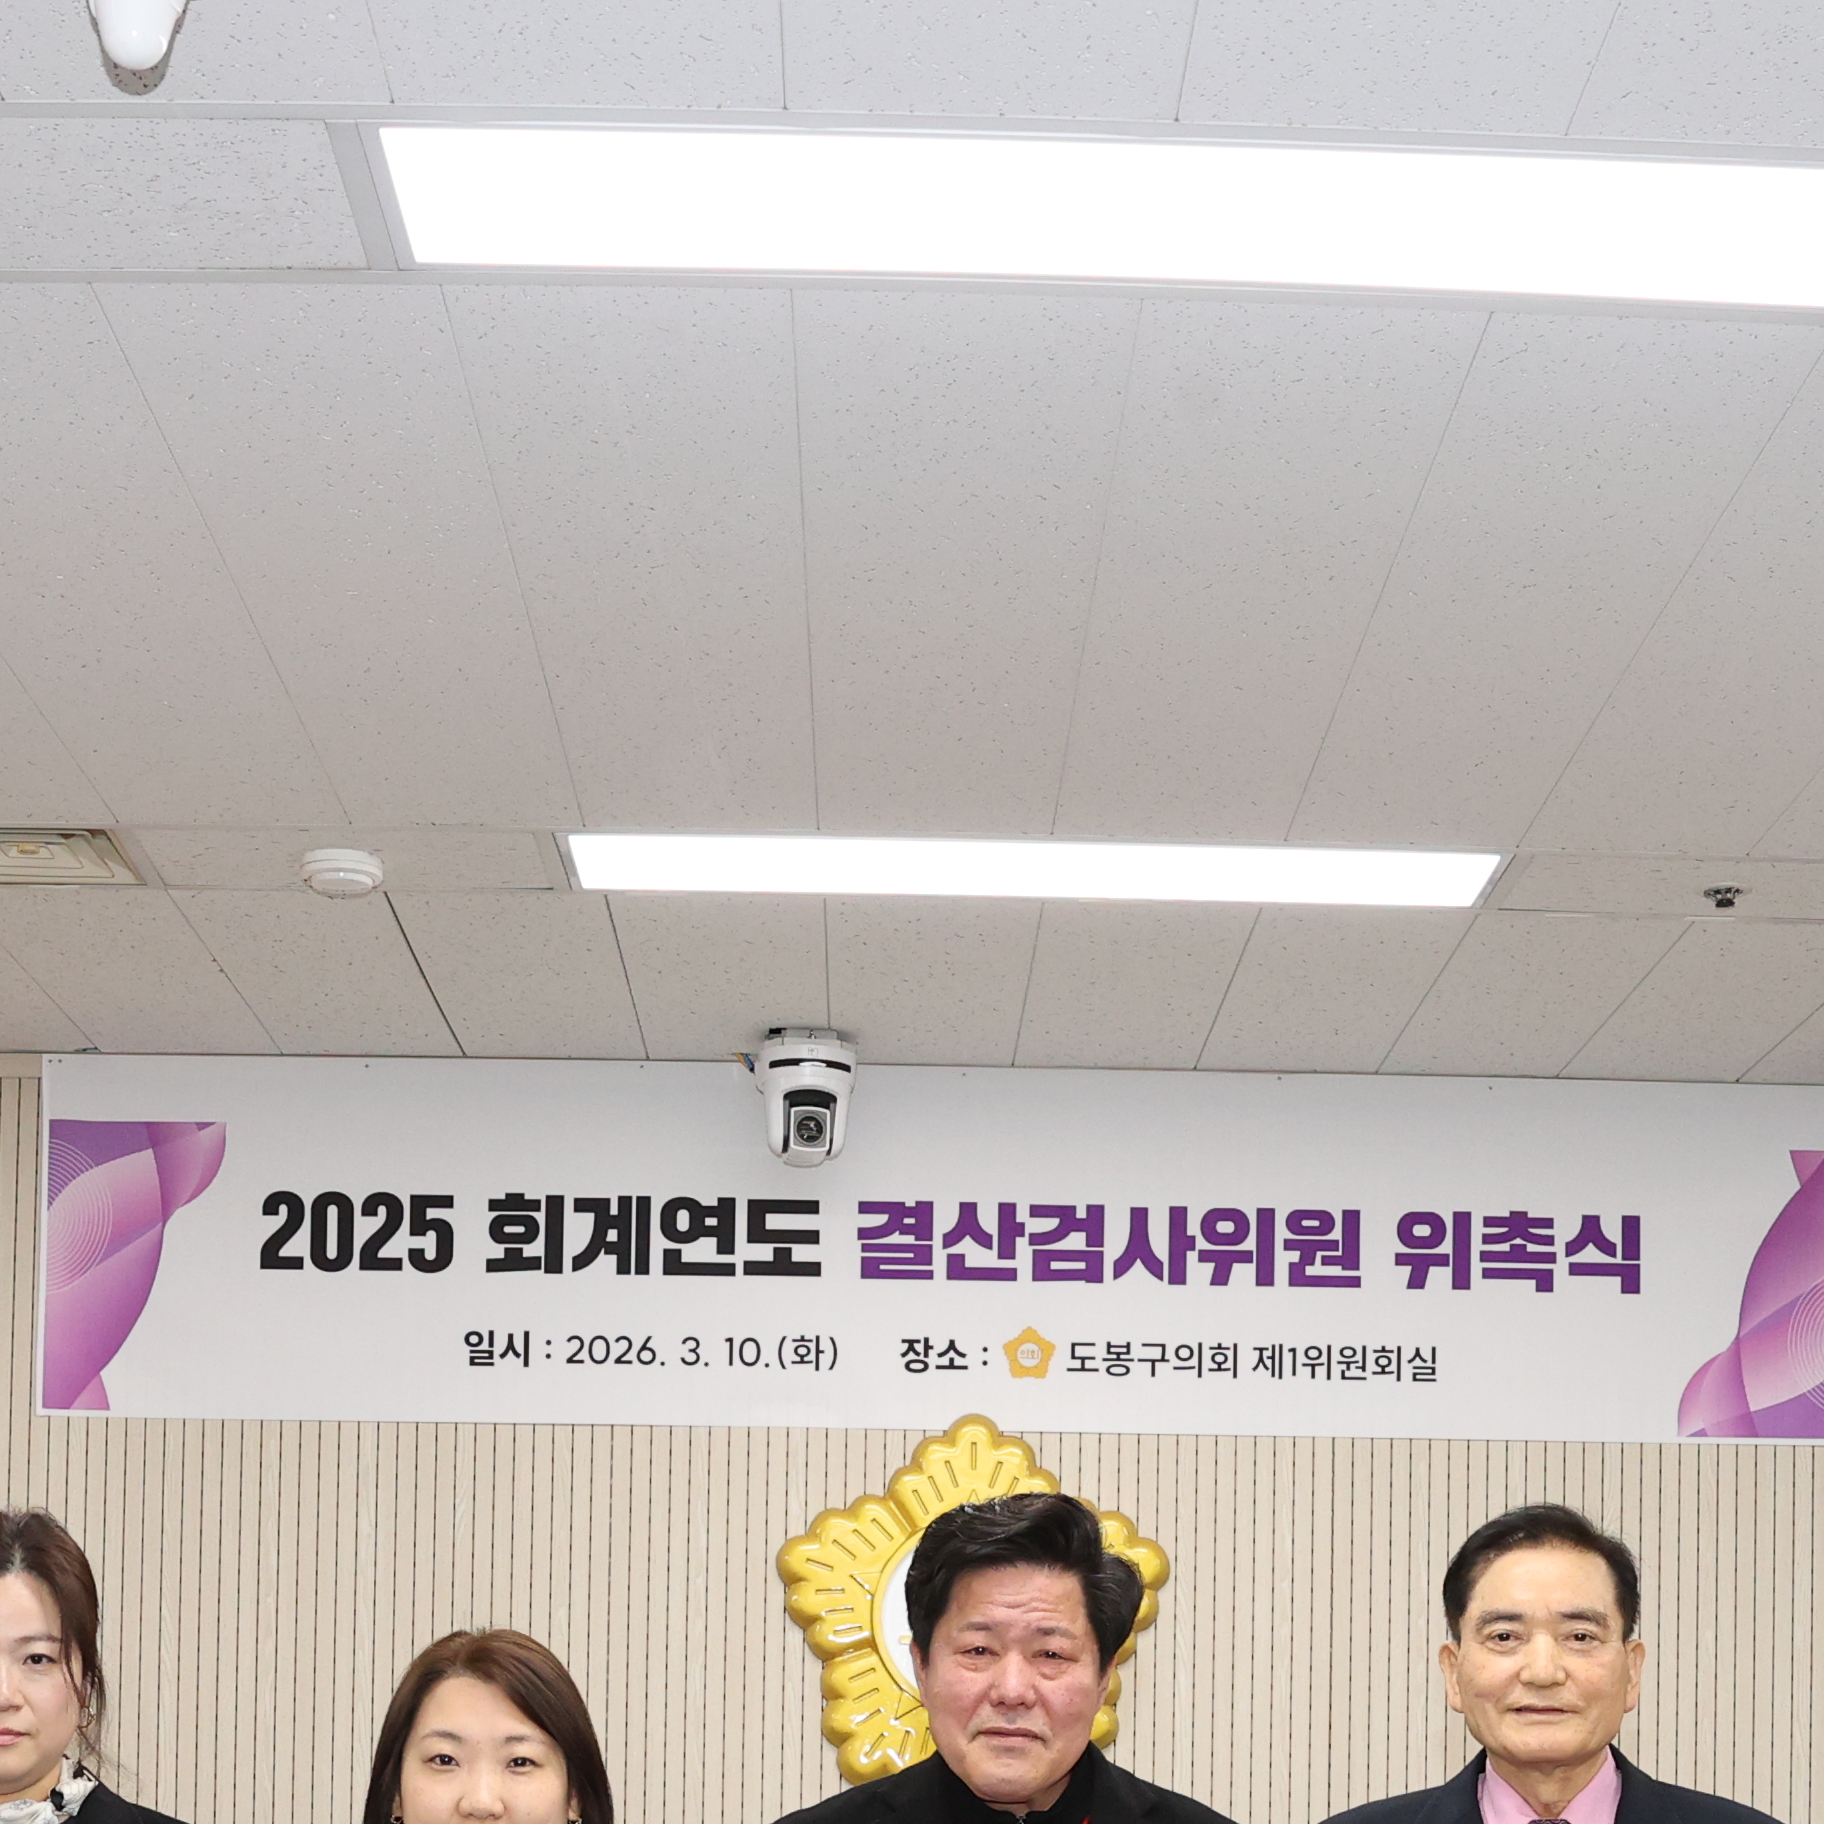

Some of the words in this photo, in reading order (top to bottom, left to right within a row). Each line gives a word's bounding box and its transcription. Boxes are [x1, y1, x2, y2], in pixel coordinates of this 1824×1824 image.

[259, 1190, 455, 1274] 2025
[485, 1192, 822, 1278] 회계연도
[856, 1200, 1362, 1289] 결산검사위원
[1394, 1210, 1641, 1295] 위촉식
[463, 1329, 531, 1368] 일시
[565, 1334, 666, 1367] 2026.
[679, 1336, 710, 1368] 3.
[724, 1334, 838, 1372] 10.(화)
[899, 1336, 969, 1374] 장소
[1066, 1340, 1238, 1380] 도봉구의회
[1251, 1343, 1438, 1383] 제1위원회실
